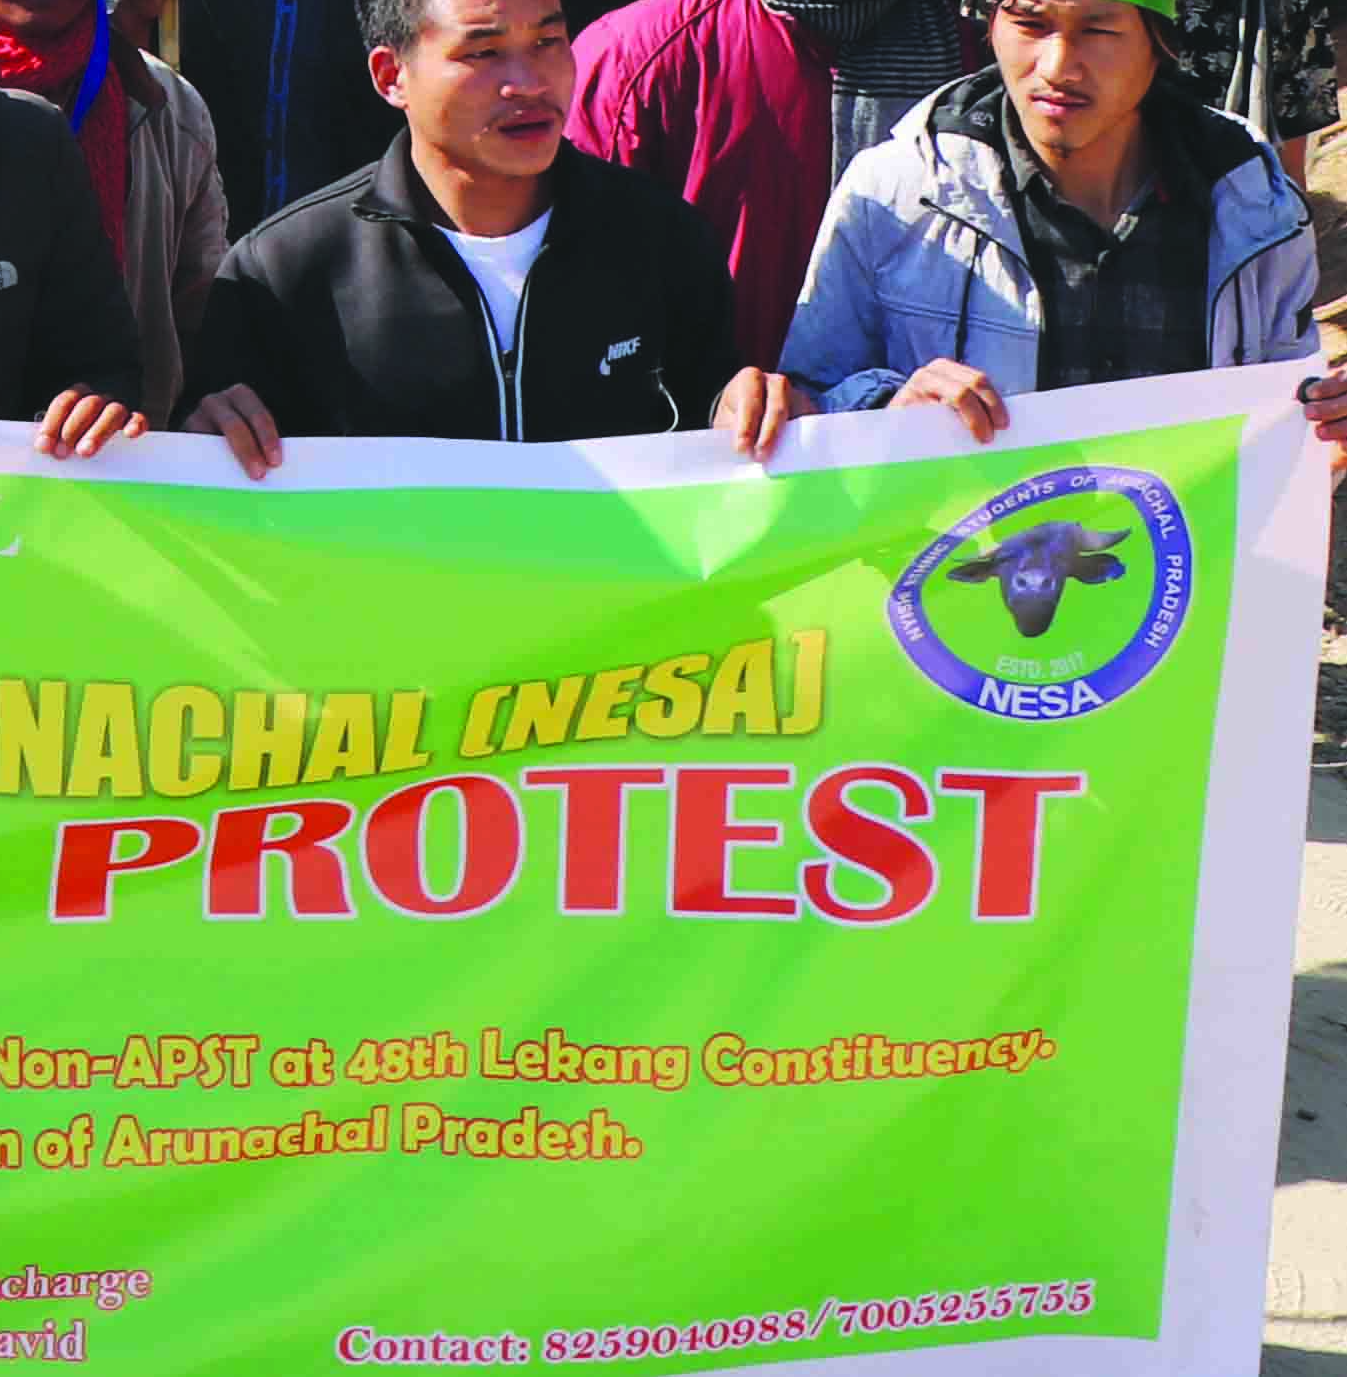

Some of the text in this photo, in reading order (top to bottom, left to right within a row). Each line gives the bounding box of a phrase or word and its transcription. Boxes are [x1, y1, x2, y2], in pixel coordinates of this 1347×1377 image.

[1144, 553, 1185, 650] PRADESH
[977, 676, 1106, 719] NESA
[47, 762, 1089, 927] PROTEST
[269, 1039, 335, 1088] at
[343, 1031, 467, 1087] 48th
[479, 1027, 690, 1092] Lekang
[701, 1028, 1058, 1088] Constituency.
[33, 1113, 96, 1169] of
[103, 1103, 389, 1168] Arunachal
[402, 1103, 644, 1160] Pradesh.
[336, 1326, 532, 1366] Contact:
